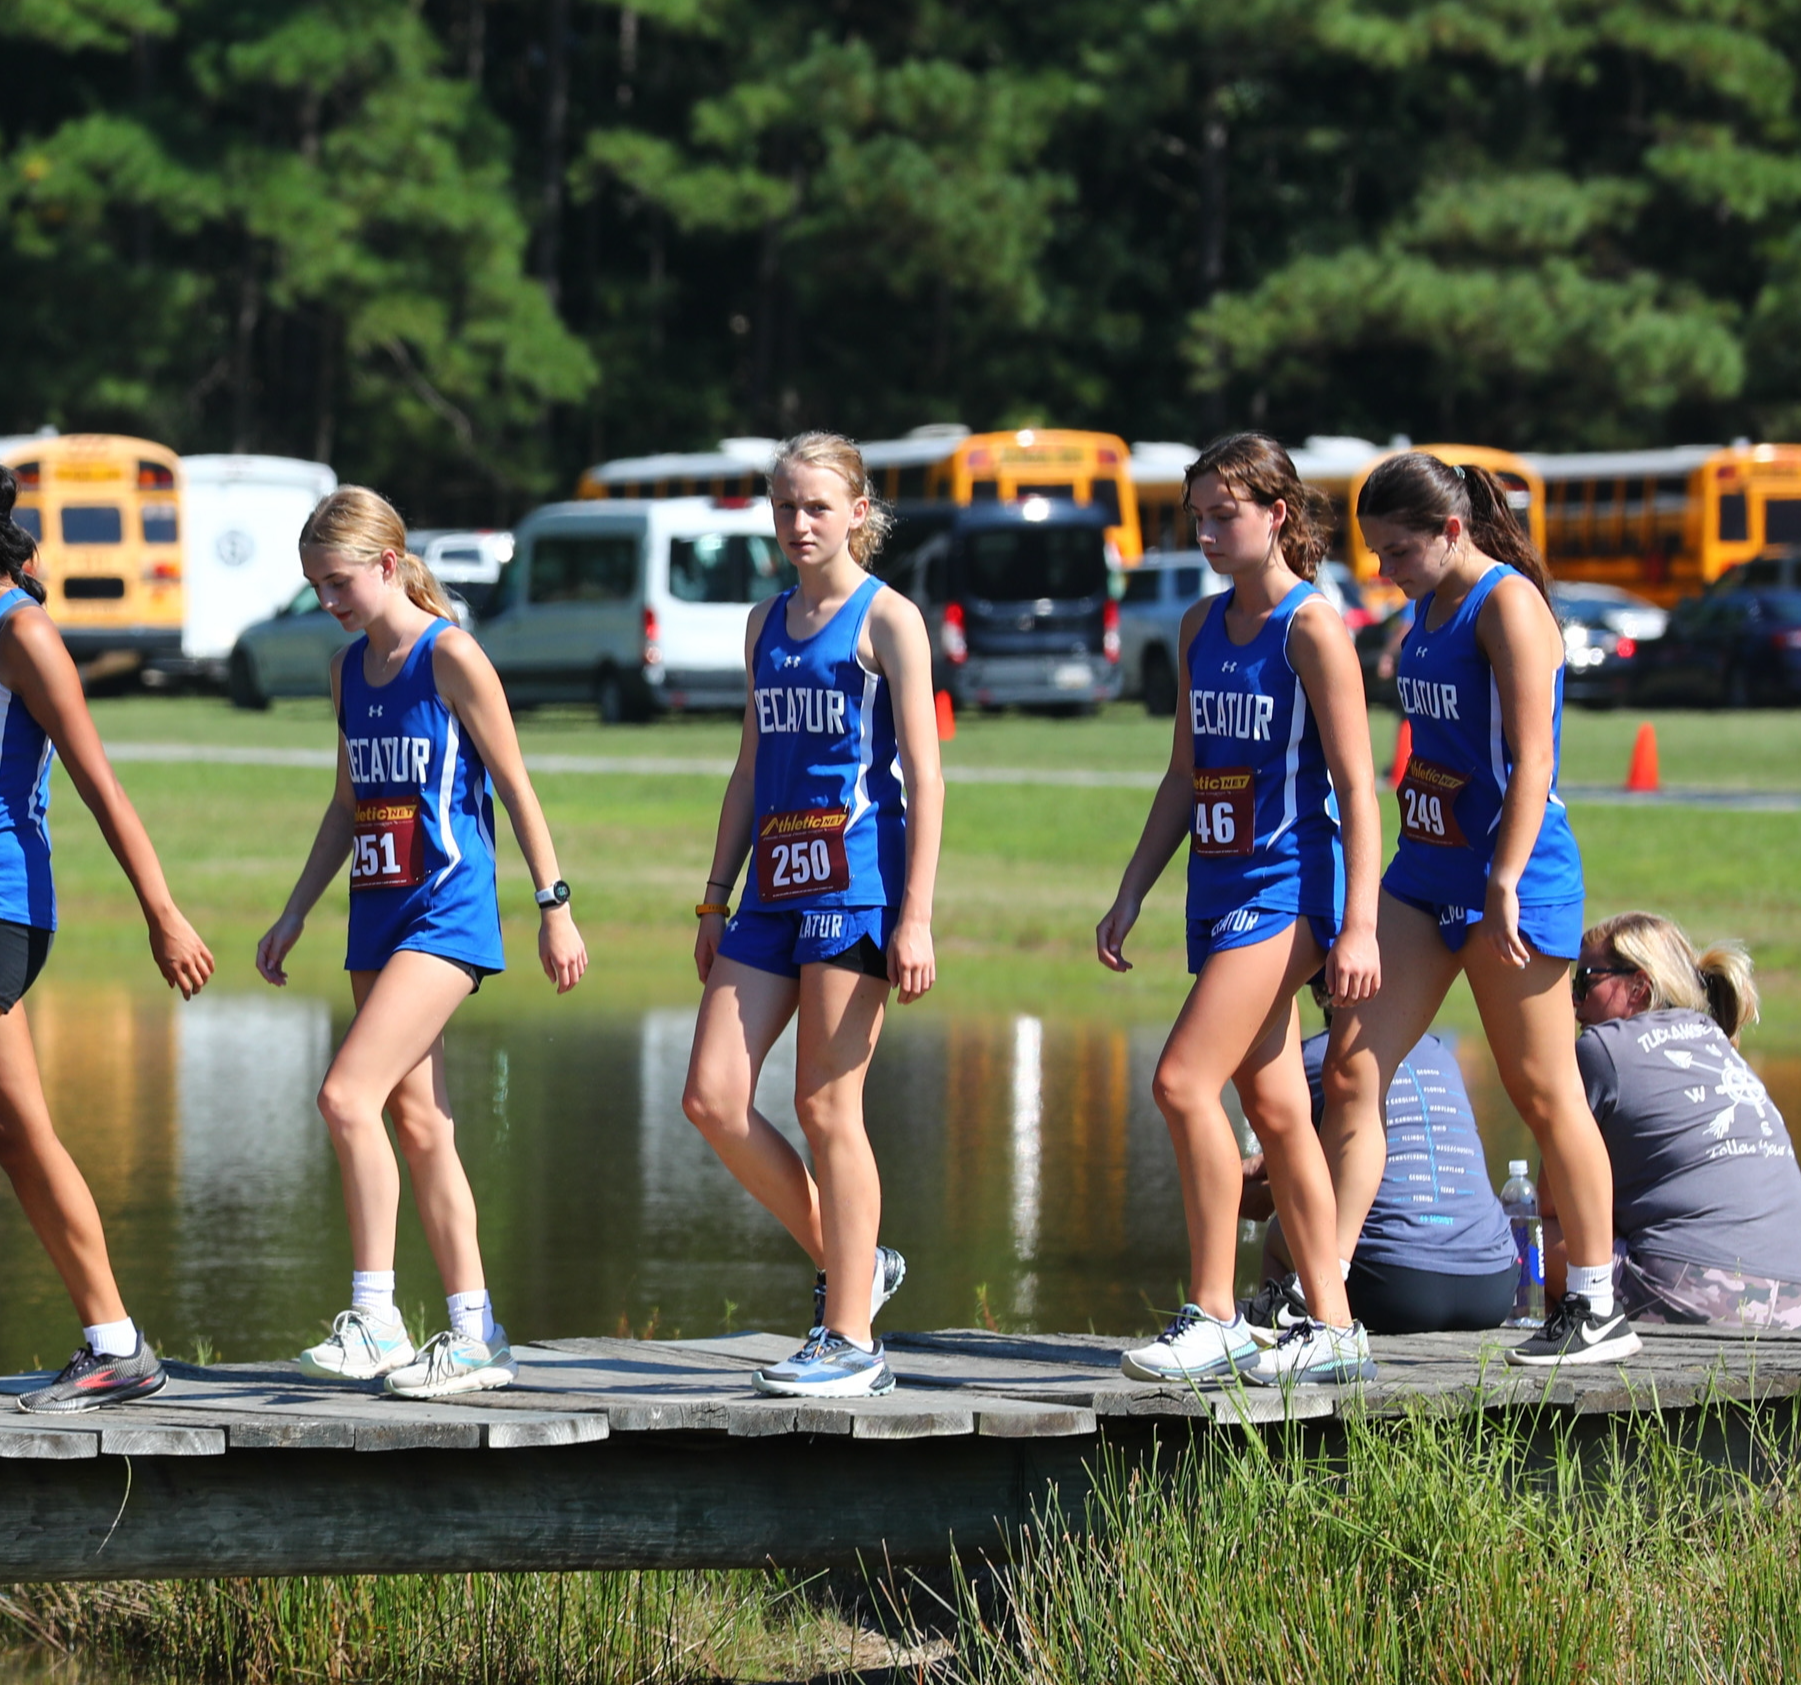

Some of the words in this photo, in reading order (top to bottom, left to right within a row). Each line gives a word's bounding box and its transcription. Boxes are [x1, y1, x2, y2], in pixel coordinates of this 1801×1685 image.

[1405, 788, 1445, 836] 249
[760, 814, 822, 836] Athletic
[771, 839, 831, 887] 250
[1390, 1078, 1412, 1086] LORIDA
[1423, 1086, 1446, 1094] FLORIDA
[1684, 1085, 1705, 1103] W
[1390, 1095, 1418, 1106] CAROLINA
[1429, 1104, 1457, 1115] MARYLAND
[1394, 1115, 1422, 1125] CAROLINA
[1402, 1134, 1425, 1142] ILLINOIS
[1438, 1165, 1465, 1175] MARYLAND
[1440, 1186, 1455, 1194] TEXAS
[1413, 1195, 1433, 1203] FLORIDA
